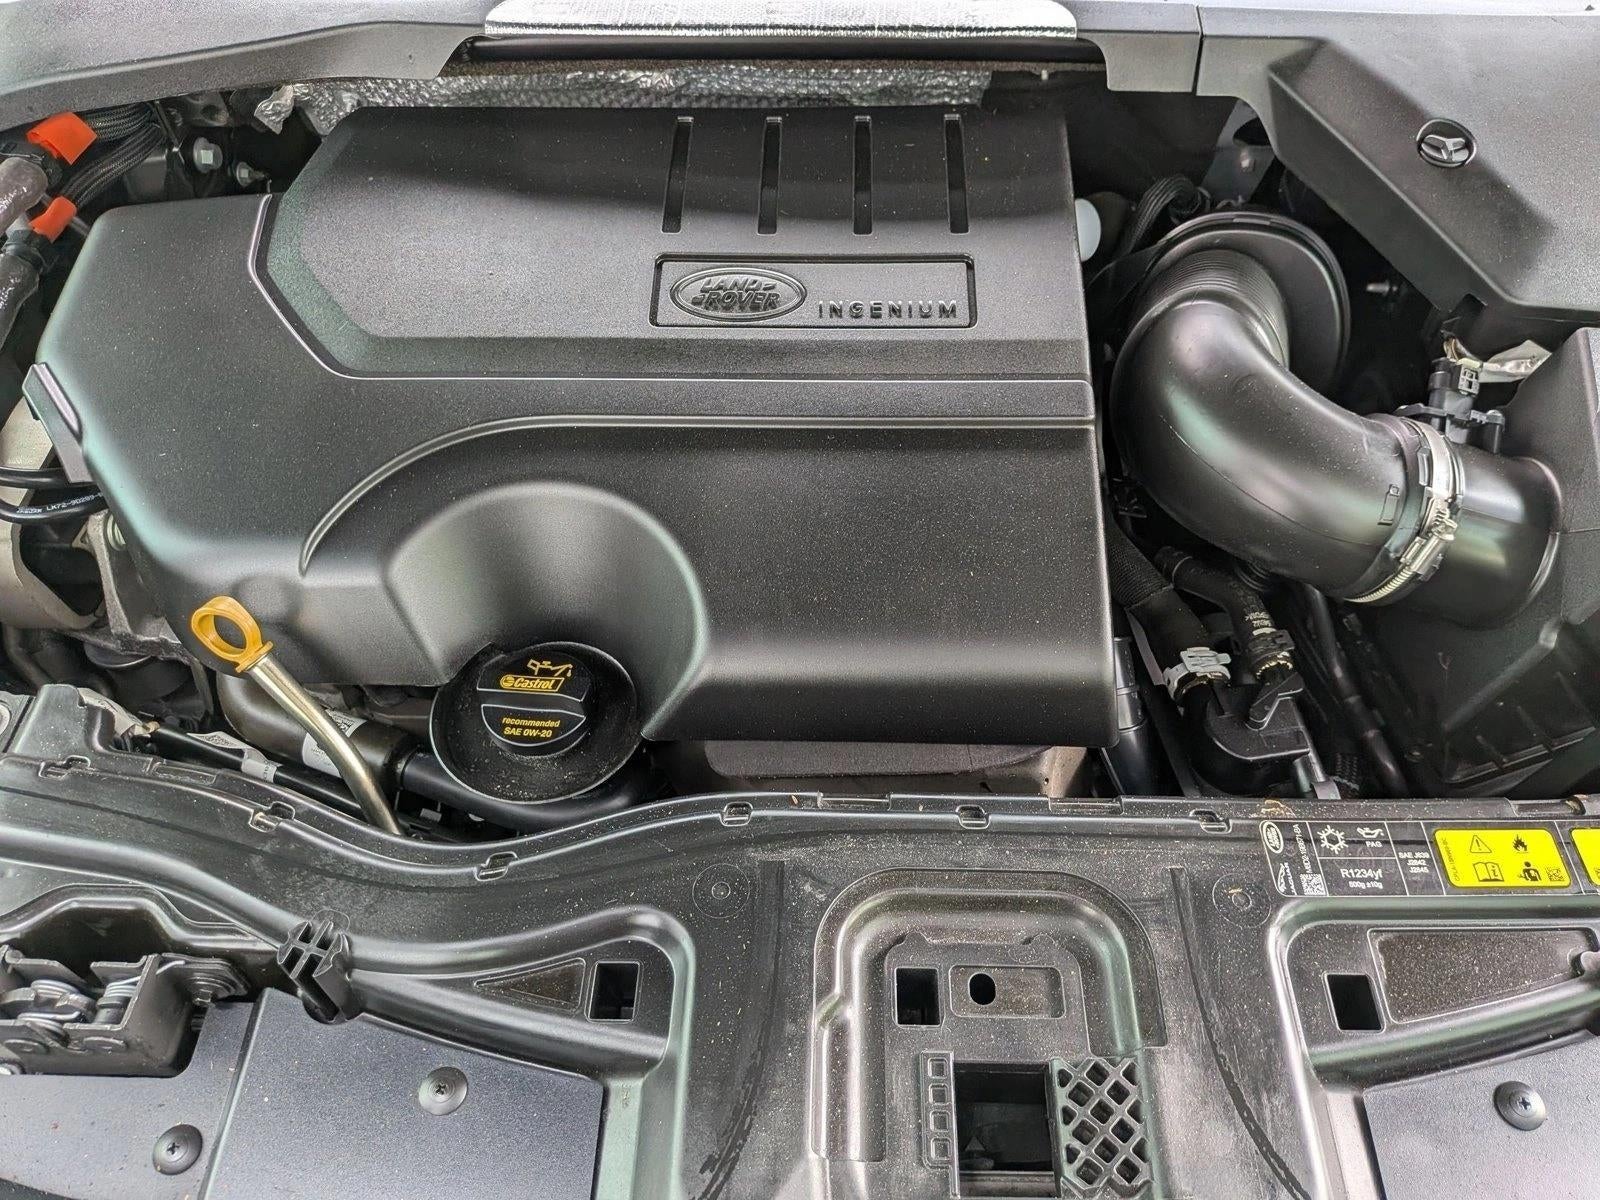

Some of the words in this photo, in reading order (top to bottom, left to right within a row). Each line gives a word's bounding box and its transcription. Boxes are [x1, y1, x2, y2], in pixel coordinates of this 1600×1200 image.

[700, 277, 764, 293] LAND
[702, 291, 780, 310] ROVER
[817, 300, 957, 319] INGENIUM
[514, 677, 555, 689] Castrol
[502, 717, 560, 728] recommended
[504, 726, 522, 735] SAE
[523, 728, 552, 737] 0W-20
[1284, 862, 1296, 892] JAGUAR
[1340, 868, 1383, 880] R1234yf
